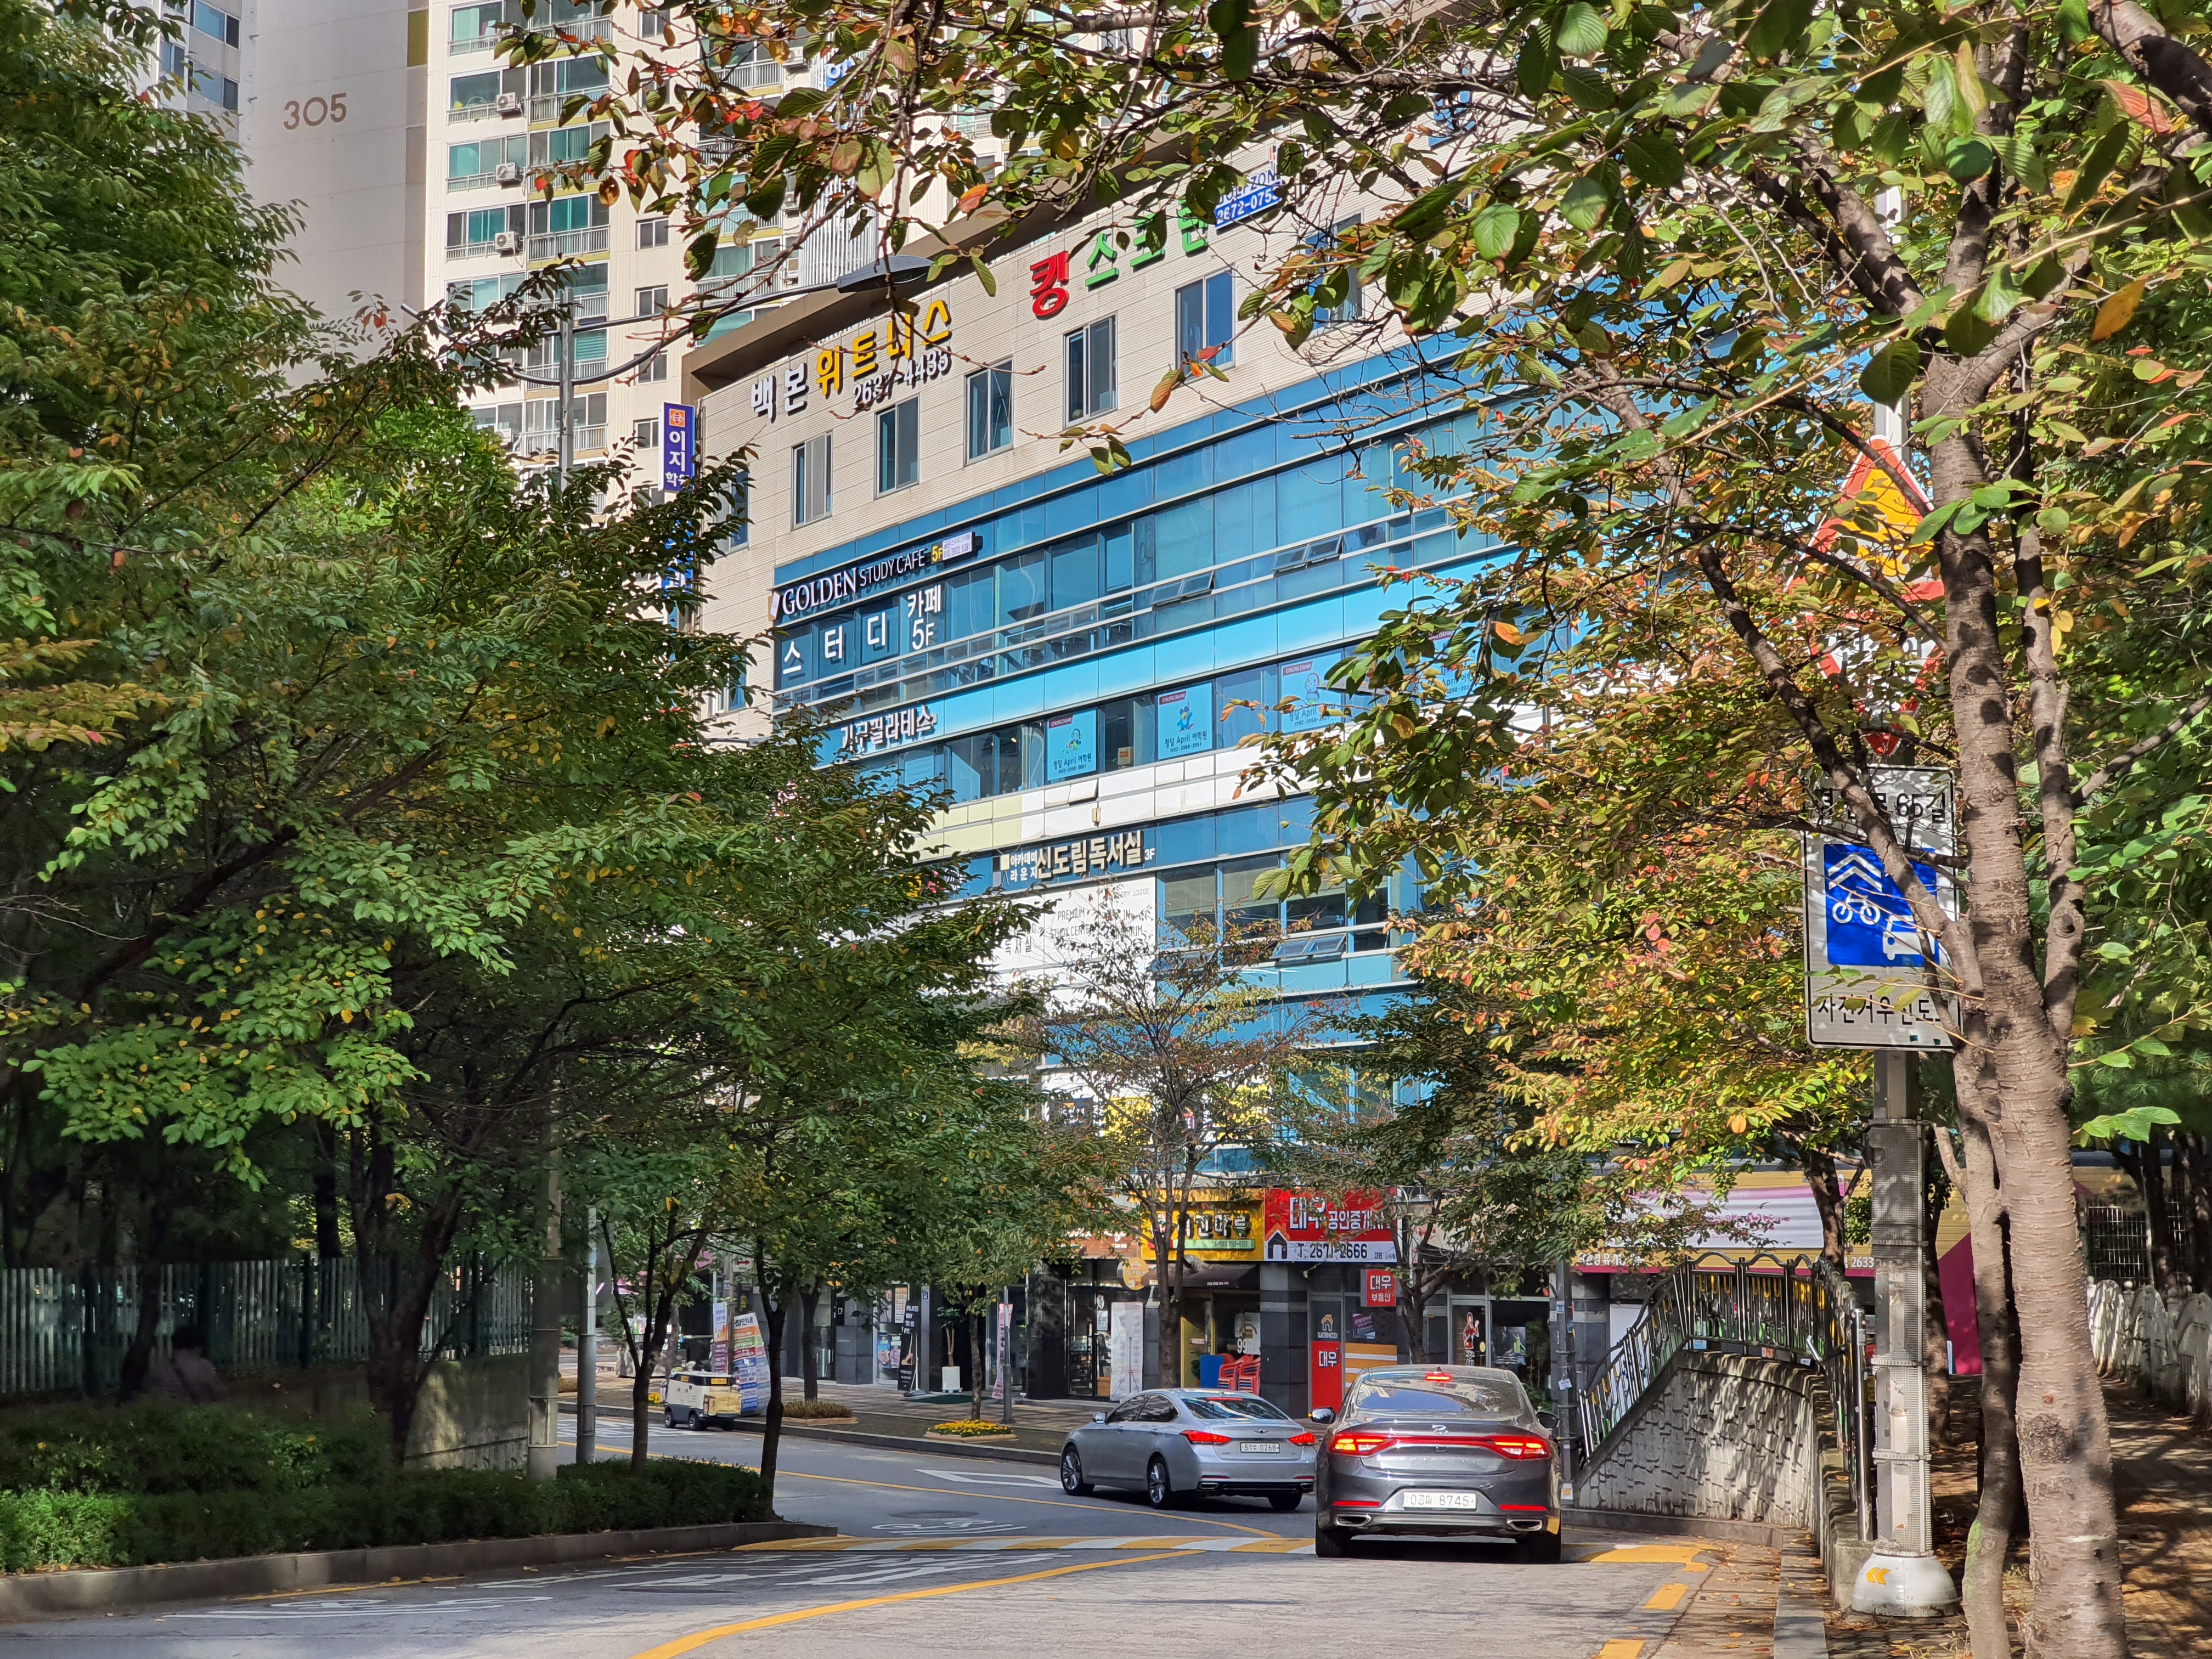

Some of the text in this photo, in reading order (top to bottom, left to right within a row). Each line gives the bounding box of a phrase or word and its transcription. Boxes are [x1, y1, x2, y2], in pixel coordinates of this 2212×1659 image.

[283, 92, 347, 130] 305
[782, 545, 943, 614] GOLDEN STUDY CAFE 5F
[907, 585, 941, 618] 카페
[912, 618, 934, 650] 5F
[1301, 708, 1317, 718] April
[841, 704, 932, 751] 기구필라테스
[1165, 730, 1207, 748] 청담 April 어학원
[1053, 752, 1092, 770] 청담 April 어학원
[1011, 830, 1155, 879] 아카데미 신도림독서실 3F
[1058, 907, 1085, 921] PREMIUM
[1818, 994, 1948, 1025] 자전거우선도
[1850, 1256, 1875, 1268] 2633
[1370, 1274, 1392, 1290] 대우
[1372, 1293, 1391, 1302] 부동산
[1319, 1351, 1337, 1368] 대우
[1439, 1495, 1469, 1506] 8745
